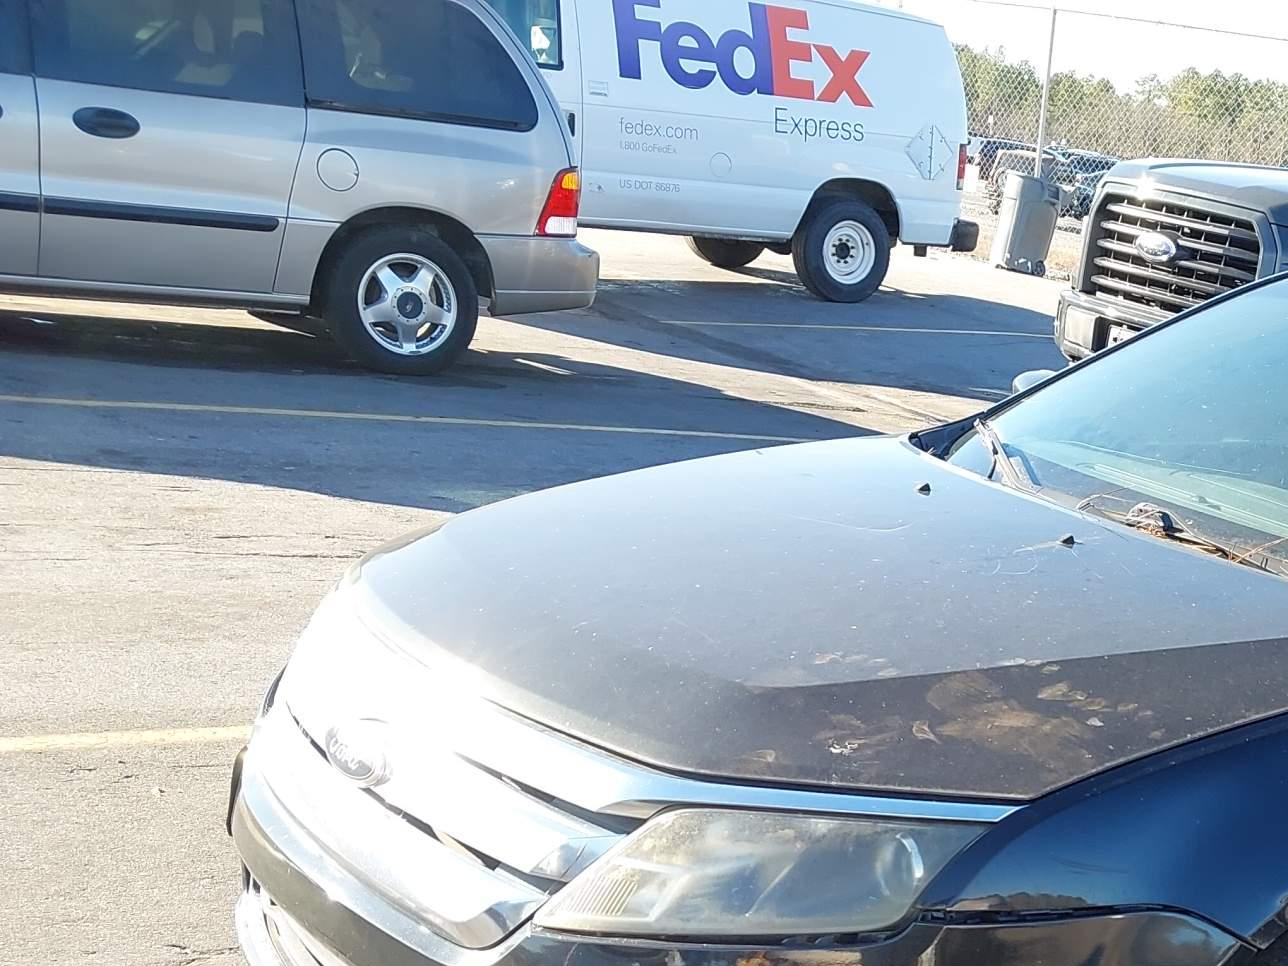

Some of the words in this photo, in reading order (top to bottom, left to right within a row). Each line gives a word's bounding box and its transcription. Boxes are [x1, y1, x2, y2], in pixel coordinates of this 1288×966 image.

[612, 0, 874, 108] FedEx
[619, 117, 699, 141] fedex.com
[774, 107, 865, 143] Express
[619, 179, 633, 190] US
[634, 180, 653, 191] DOT
